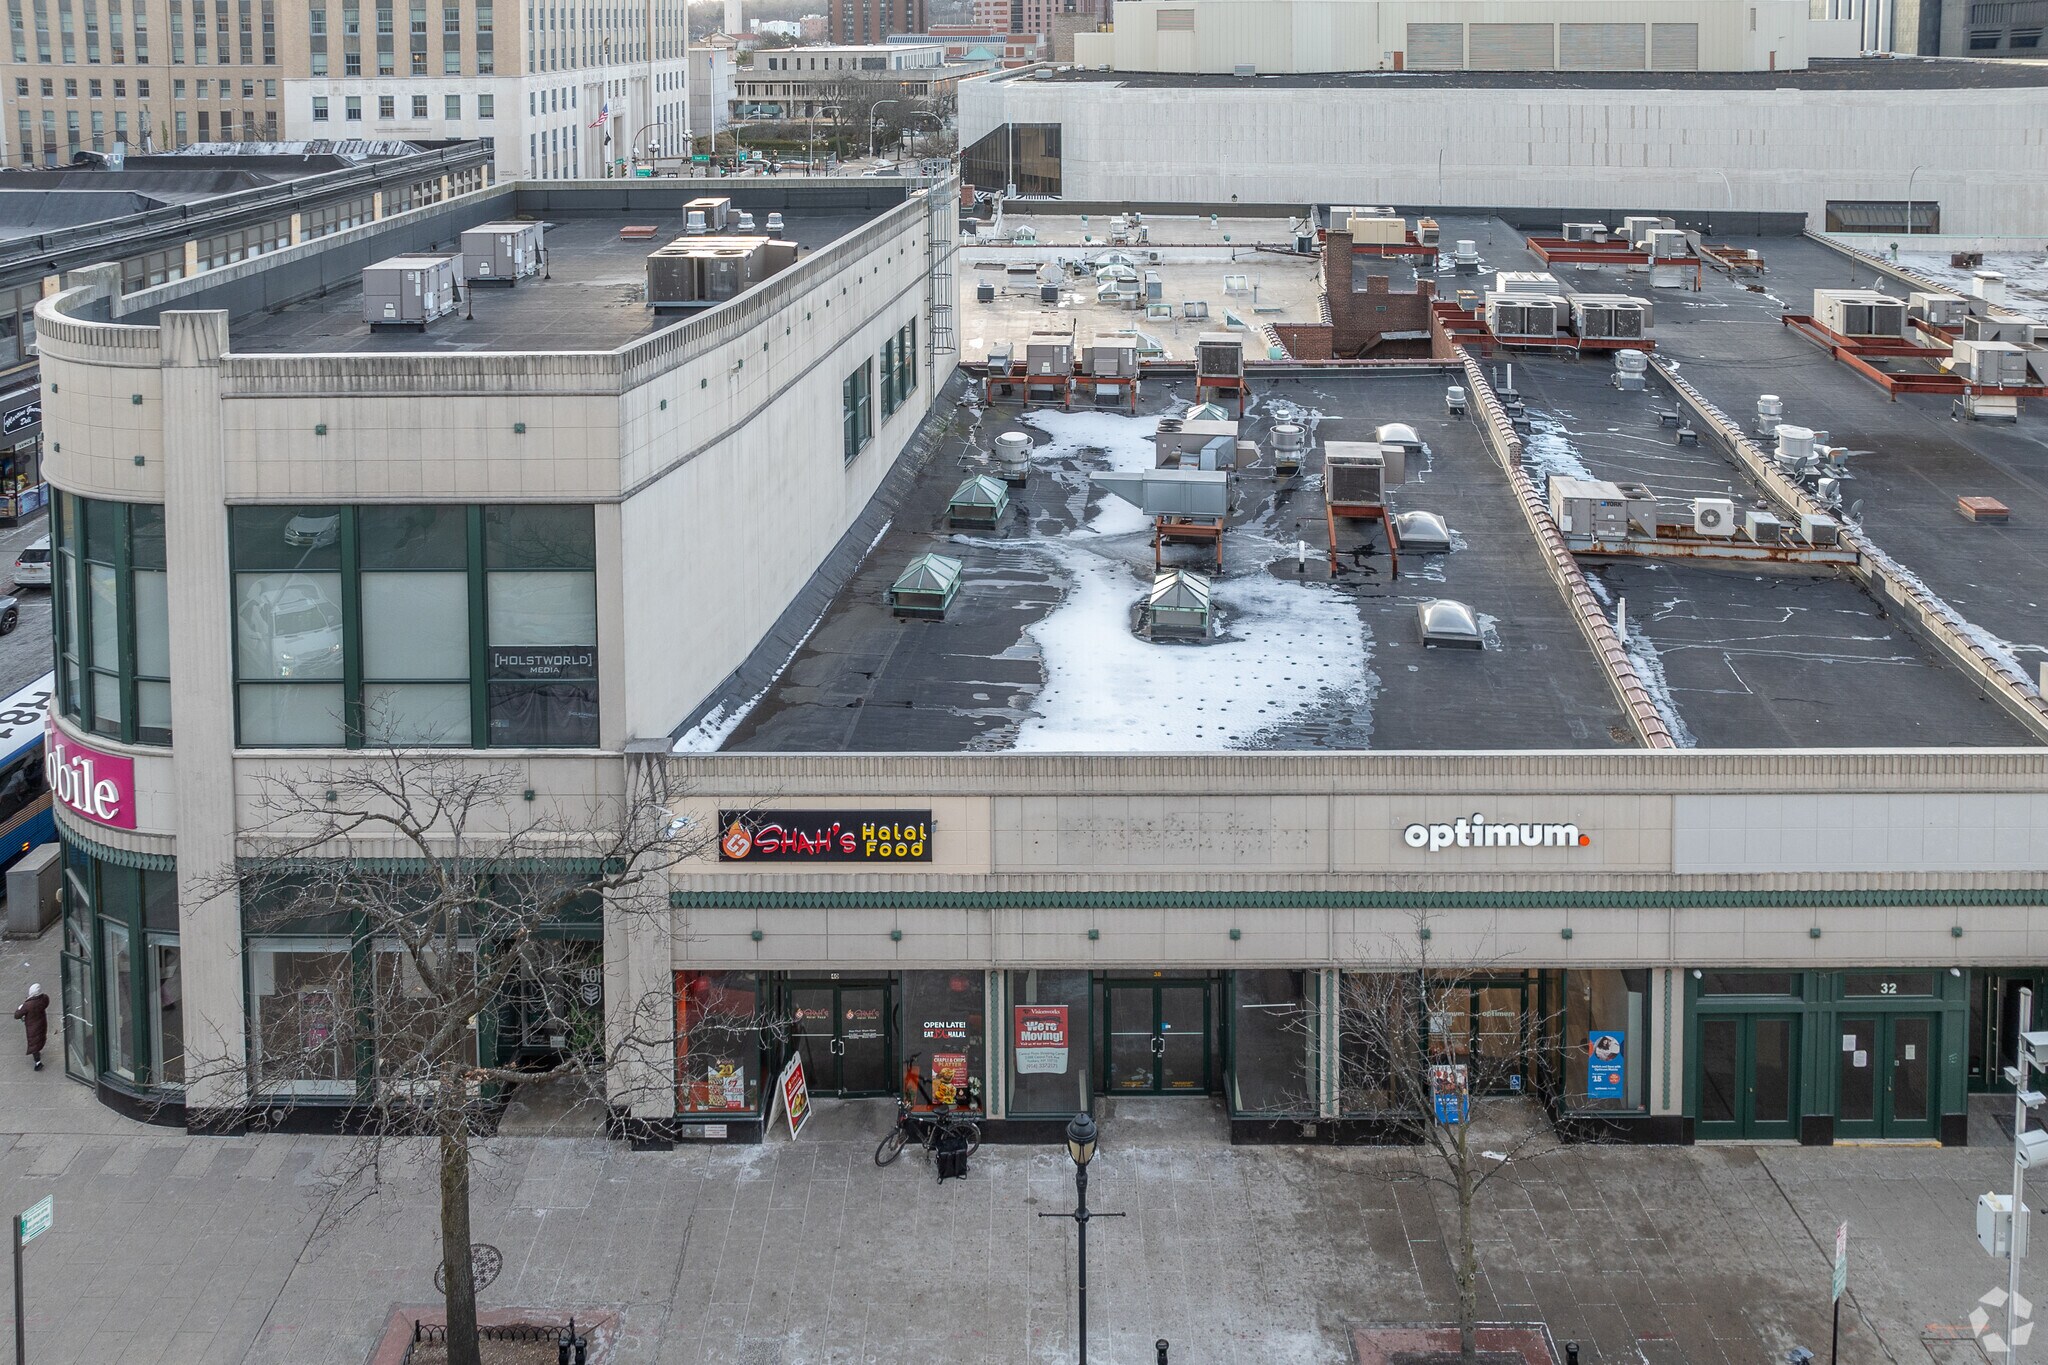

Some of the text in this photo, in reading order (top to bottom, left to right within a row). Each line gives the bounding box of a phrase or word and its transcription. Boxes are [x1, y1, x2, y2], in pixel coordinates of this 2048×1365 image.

[862, 822, 927, 842] Halal
[866, 839, 924, 857] Food
[1880, 983, 1897, 994] 32
[1026, 1021, 1057, 1031] We're
[1021, 1031, 1064, 1042] Moving!
